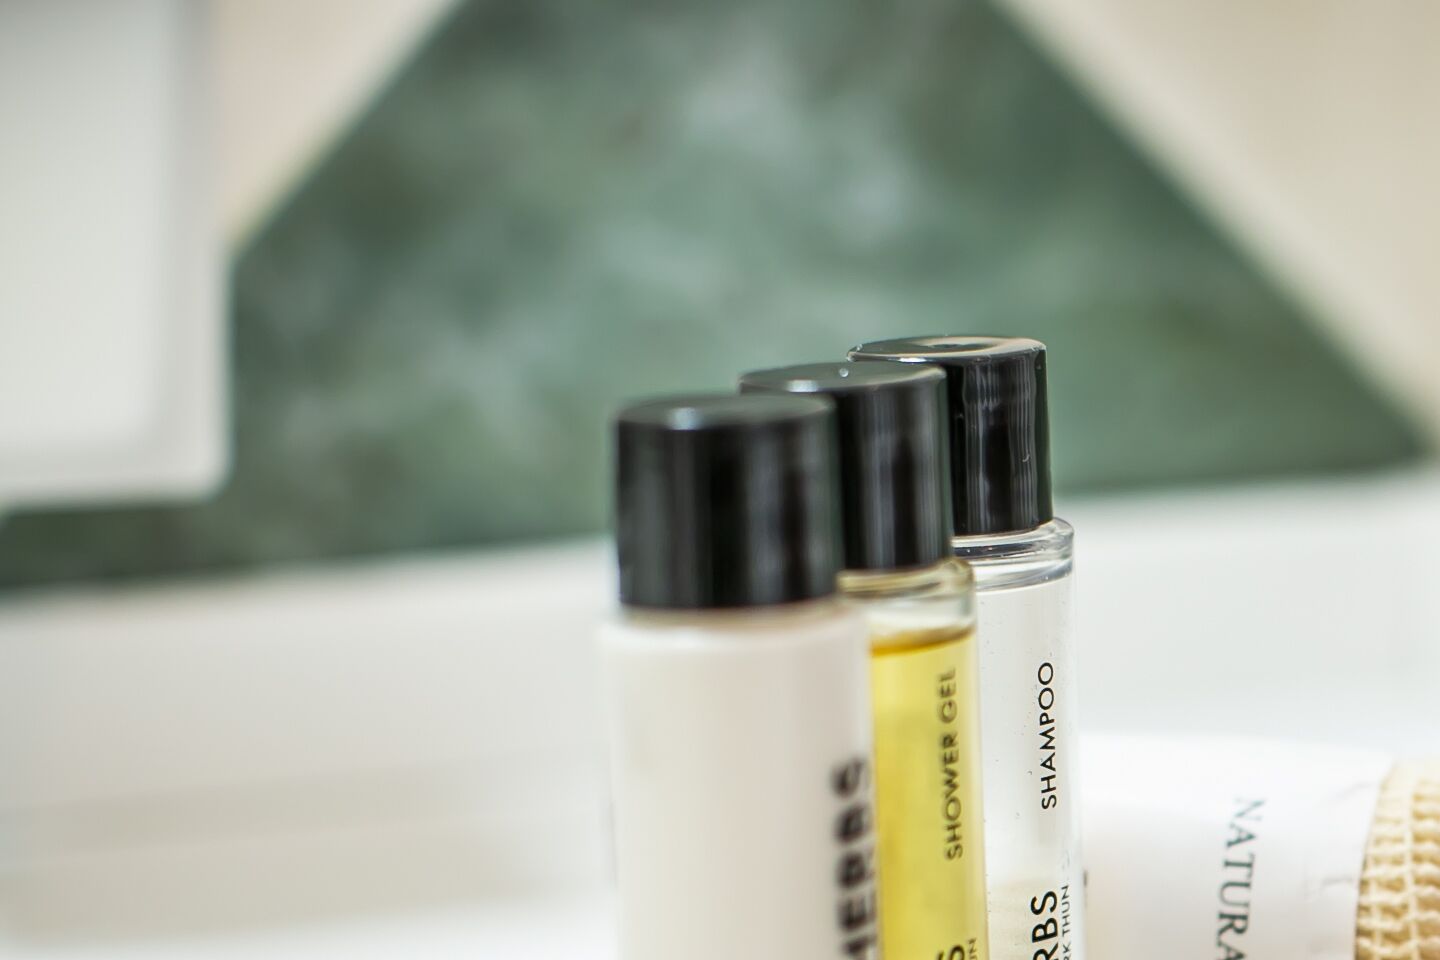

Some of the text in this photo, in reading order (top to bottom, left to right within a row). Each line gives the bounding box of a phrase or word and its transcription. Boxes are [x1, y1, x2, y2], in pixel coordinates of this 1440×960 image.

[938, 667, 963, 860] SHOWER GEL
[1038, 662, 1057, 810] SHAMPOO
[1060, 884, 1070, 936] THUN
